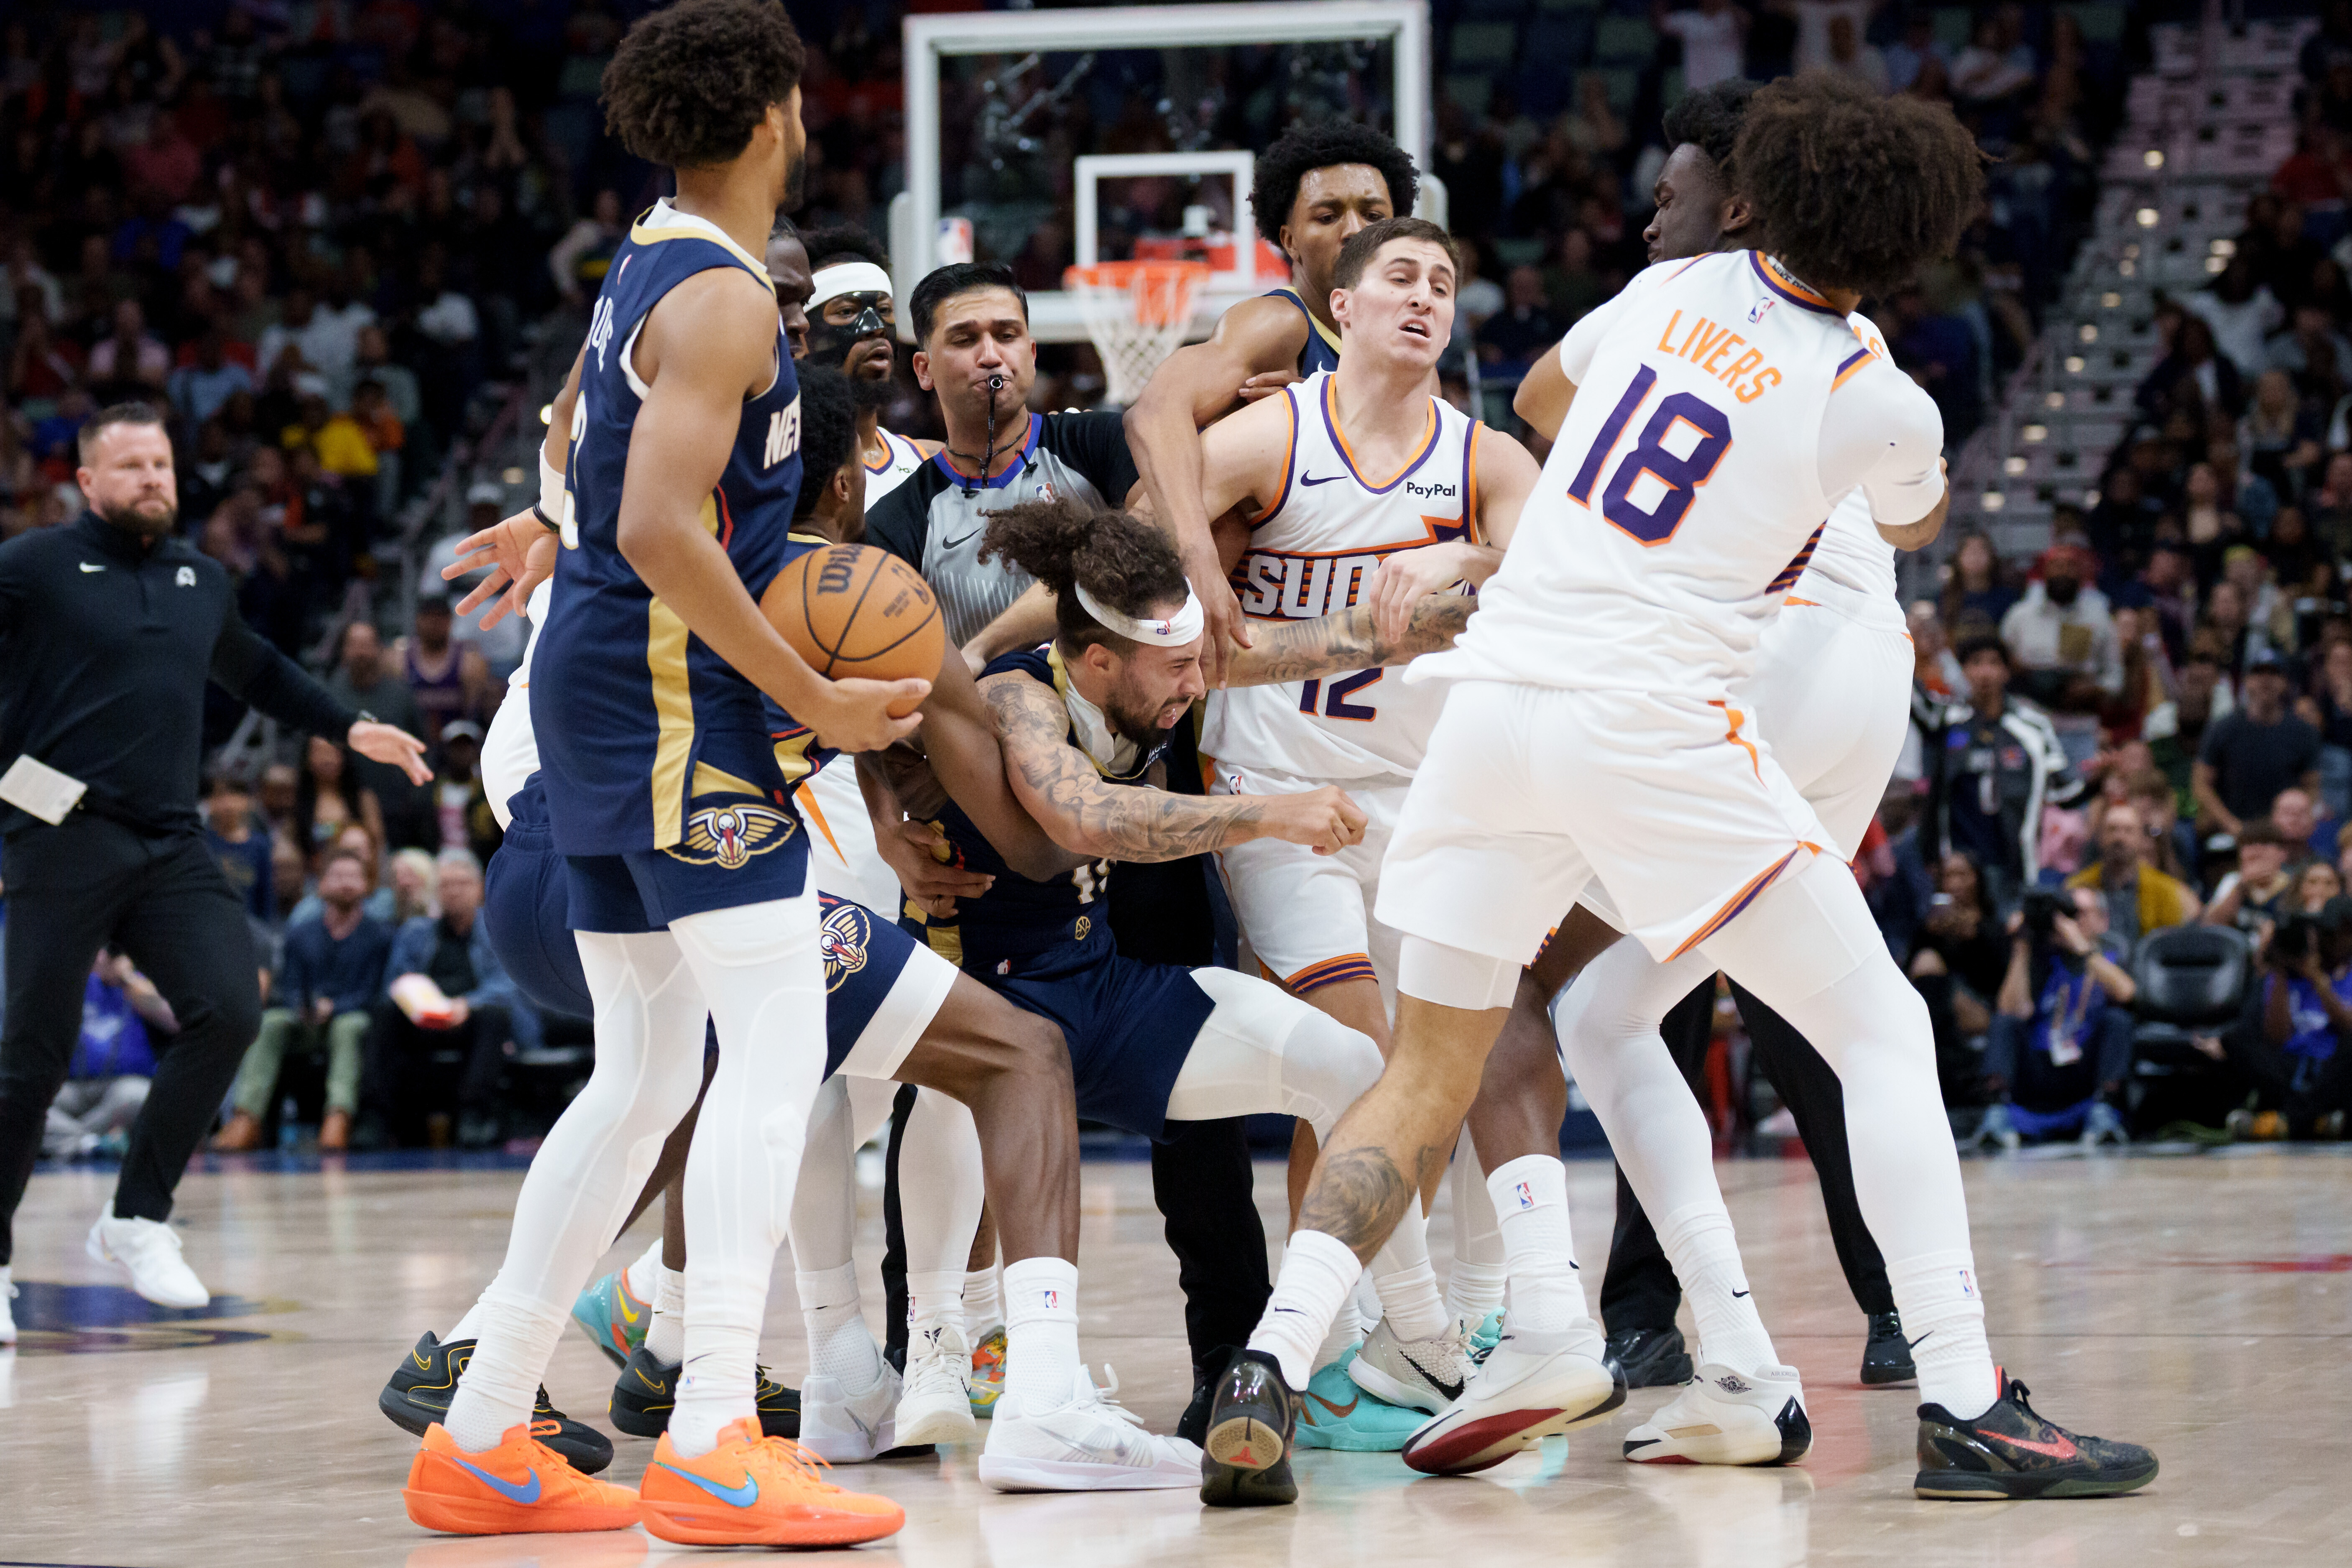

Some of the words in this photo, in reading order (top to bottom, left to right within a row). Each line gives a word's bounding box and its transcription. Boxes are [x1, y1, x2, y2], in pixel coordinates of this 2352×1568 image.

[1657, 309, 1783, 404] LIVERS
[1407, 482, 1456, 498] PayPal
[1567, 363, 1733, 547] 18
[1242, 554, 1380, 618] SUN
